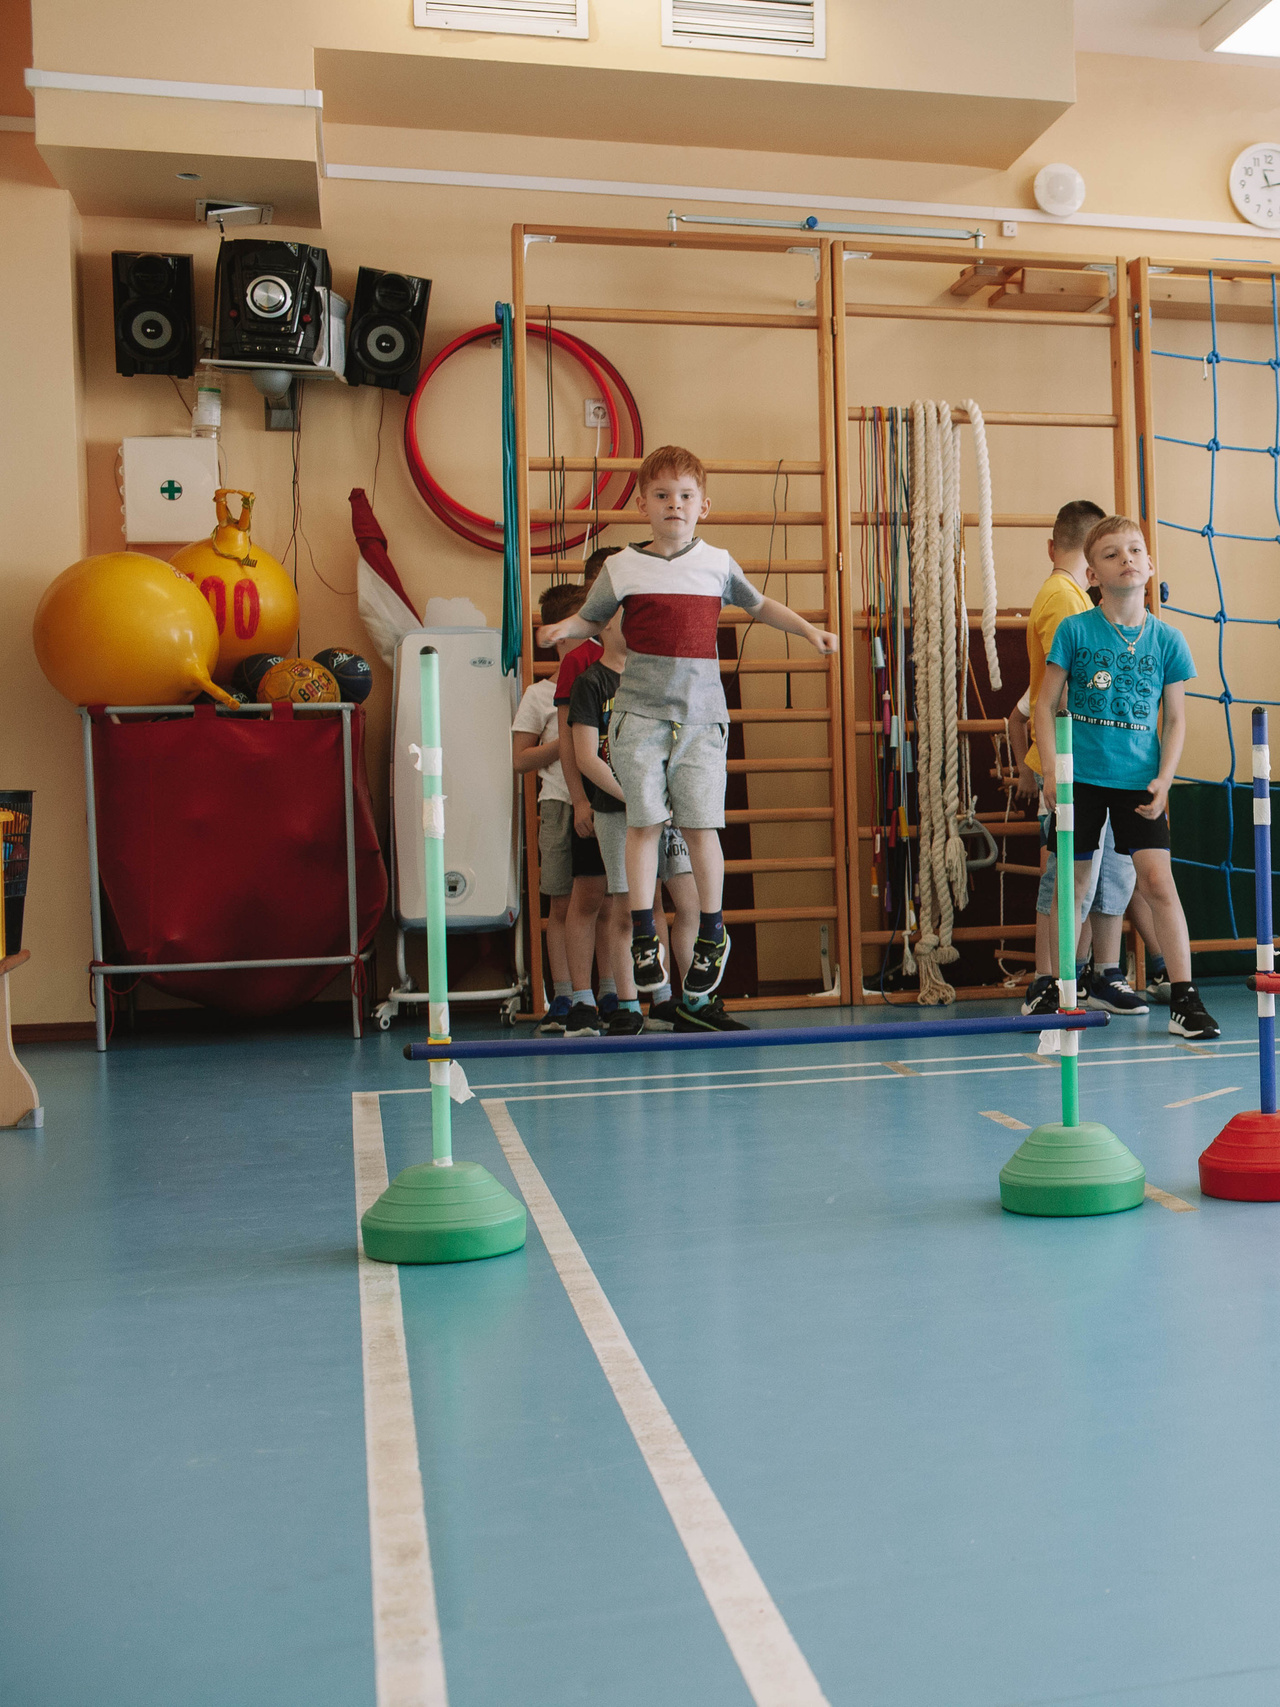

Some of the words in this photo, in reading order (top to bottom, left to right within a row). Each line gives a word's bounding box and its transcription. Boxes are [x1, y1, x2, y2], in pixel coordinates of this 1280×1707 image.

[1253, 157, 1260, 167] 11
[1264, 154, 1273, 165] 12
[1243, 166, 1253, 176] 10
[1239, 179, 1246, 189] 9
[1244, 194, 1250, 203] 8
[1255, 203, 1261, 213] 7
[1266, 208, 1273, 217] 6
[186, 573, 260, 640] 00
[1099, 719, 1115, 727] FROM
[1116, 721, 1128, 729] THE
